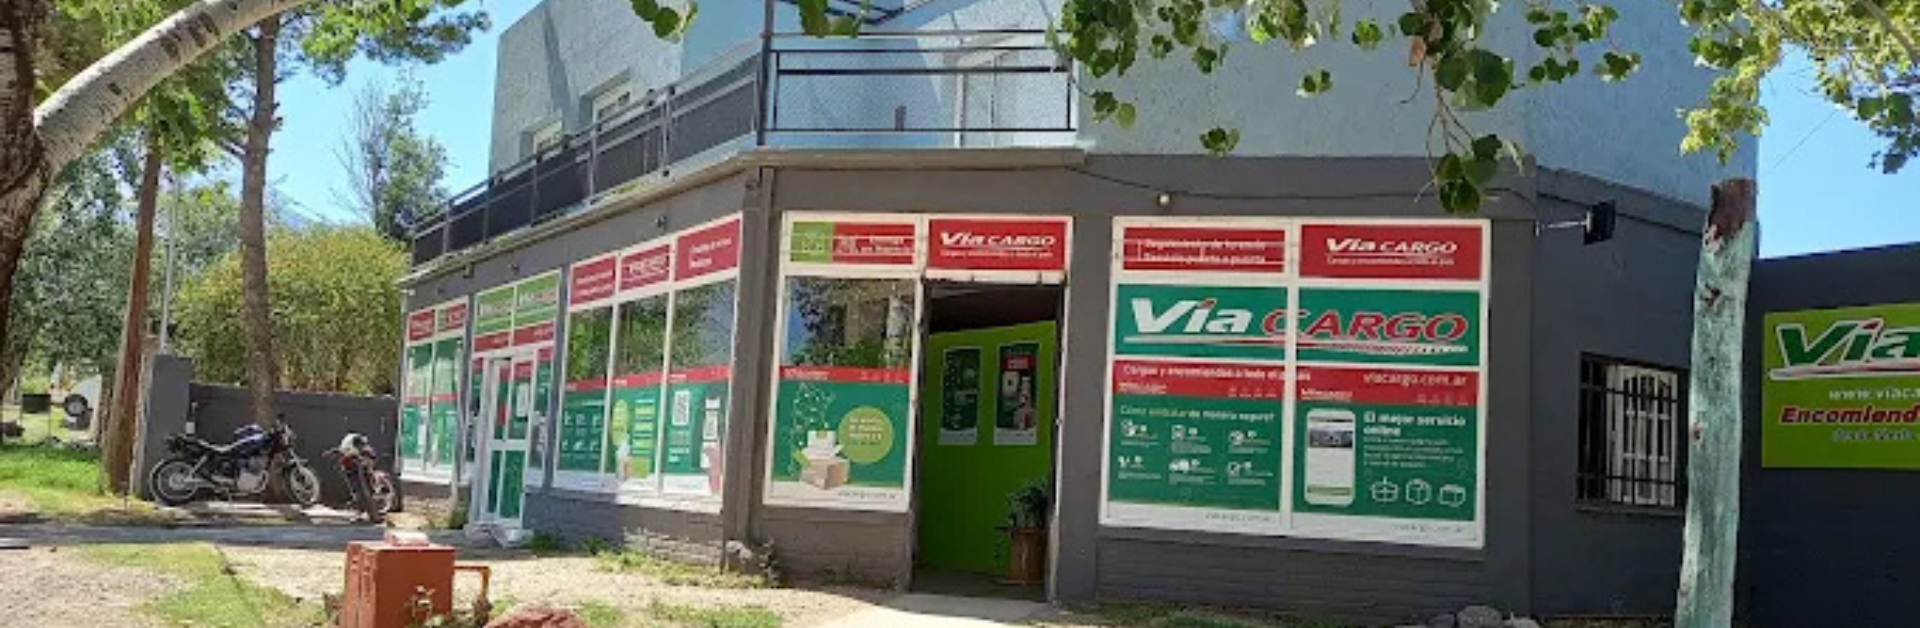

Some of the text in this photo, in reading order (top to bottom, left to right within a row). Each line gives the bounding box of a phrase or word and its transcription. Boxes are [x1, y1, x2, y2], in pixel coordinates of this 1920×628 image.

[940, 232, 1056, 247] Via CARGO
[1326, 237, 1459, 254] Via CARGO
[1131, 298, 1470, 342] Via CARGO
[1776, 318, 1920, 368] Via
